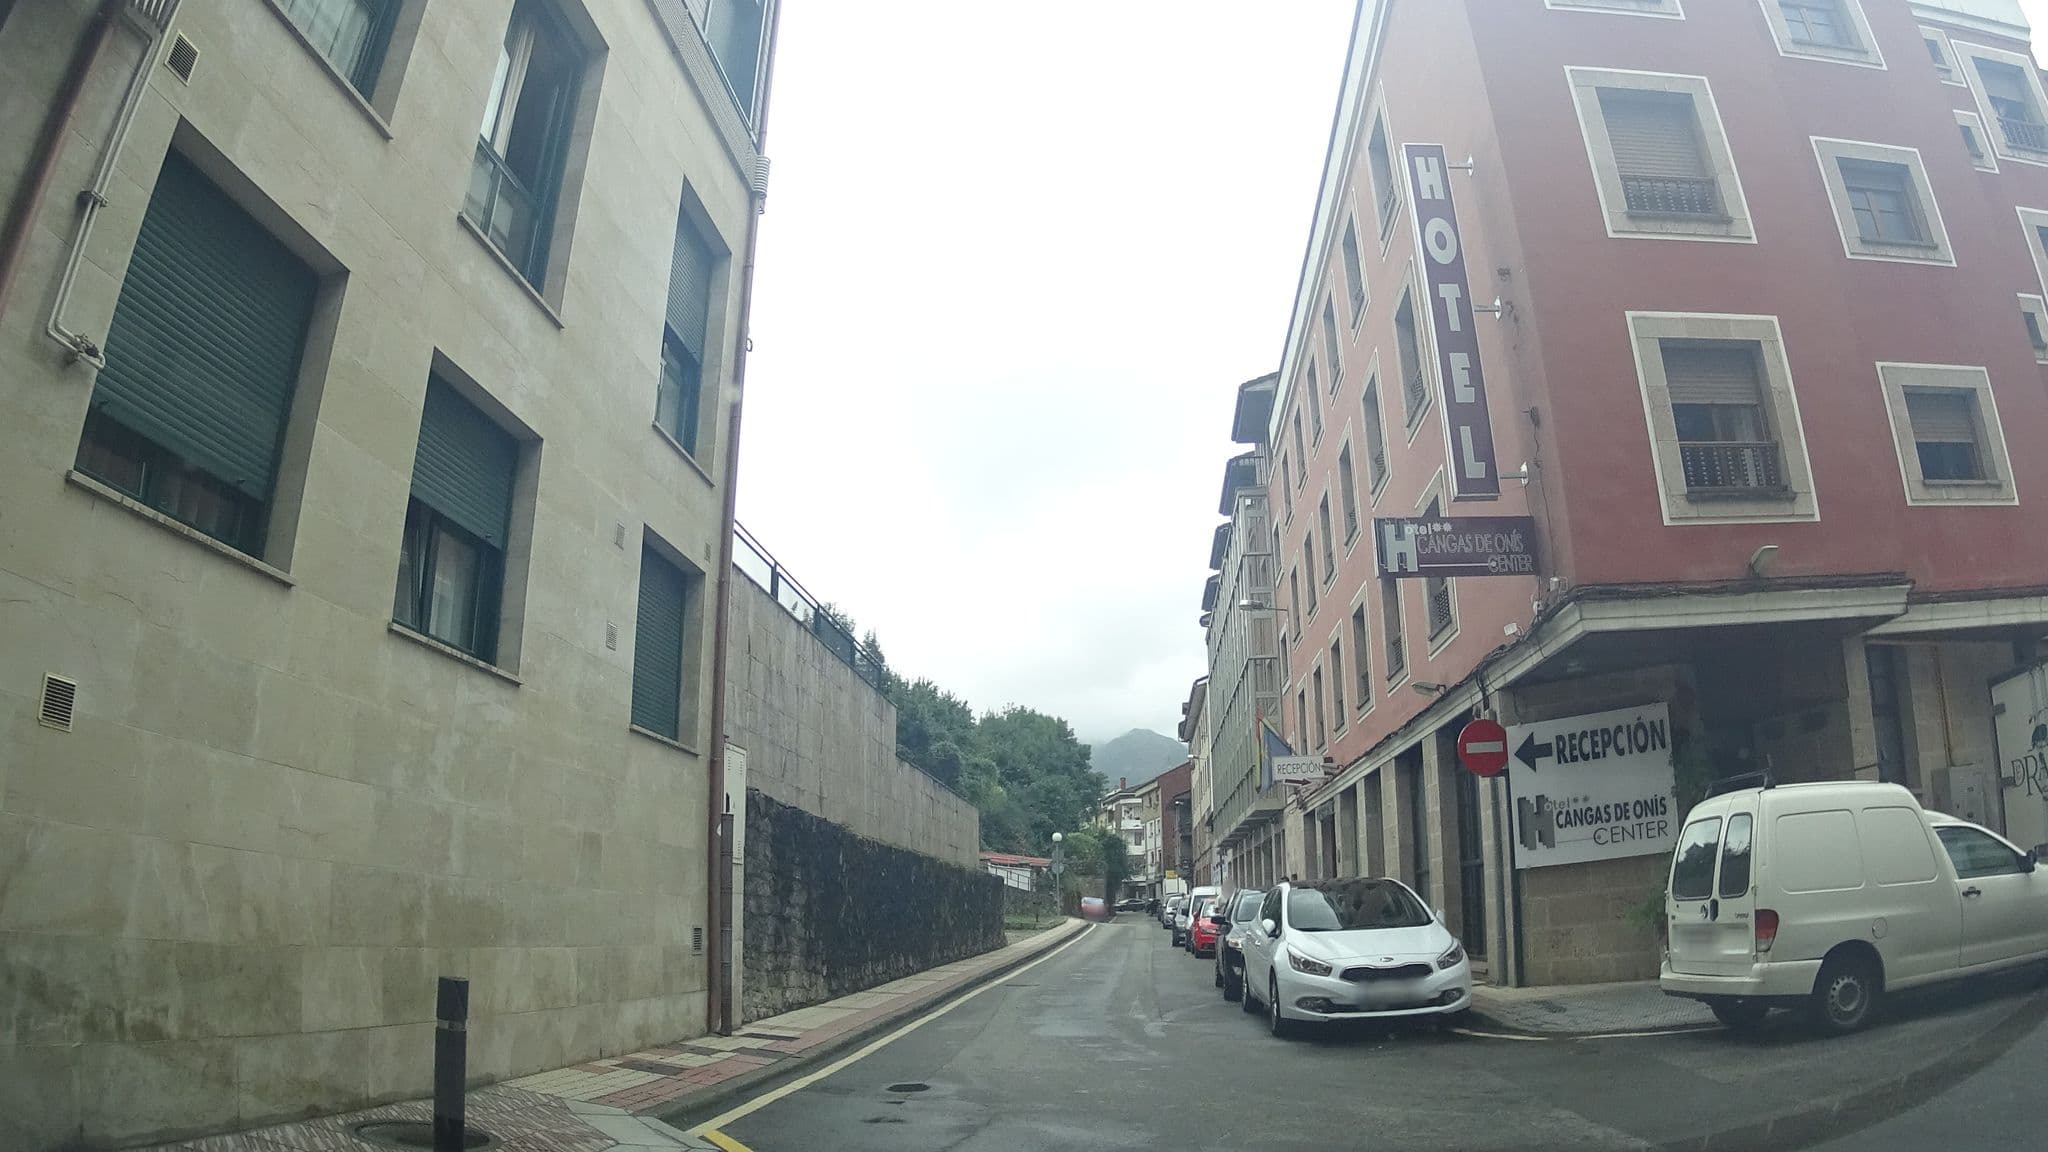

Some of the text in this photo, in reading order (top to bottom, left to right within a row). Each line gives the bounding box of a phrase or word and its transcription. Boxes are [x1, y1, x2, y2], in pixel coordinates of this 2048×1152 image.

[1414, 156, 1486, 479] HOTEL
[1416, 529, 1525, 554] CANGAS DE ONÍS
[1487, 553, 1534, 573] CENTER
[1555, 716, 1667, 765] RECEPCIÓN
[1277, 761, 1321, 775] RECEPCIÓN
[1555, 794, 1668, 830] CANGAS DE ONÍS
[1593, 819, 1669, 846] CENTER
